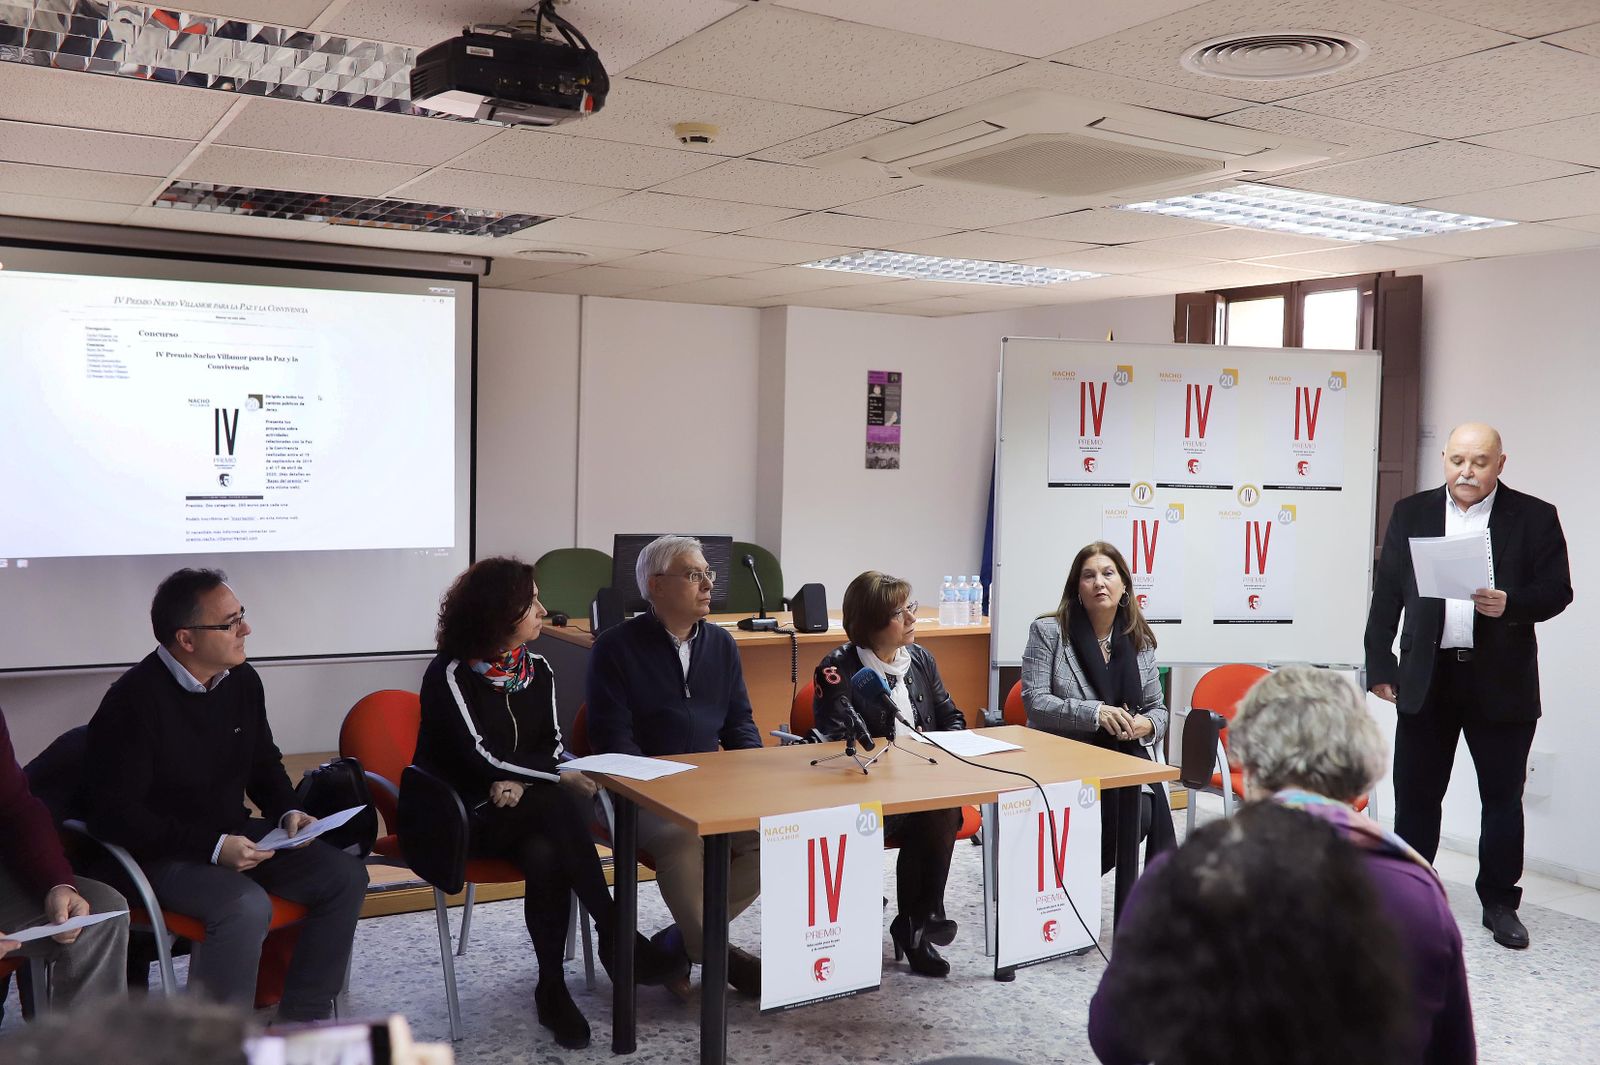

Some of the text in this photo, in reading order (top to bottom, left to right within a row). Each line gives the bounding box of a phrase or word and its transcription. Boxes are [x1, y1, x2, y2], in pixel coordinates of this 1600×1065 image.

[138, 329, 178, 338] Concurso
[1115, 372, 1128, 383] 20
[1221, 375, 1233, 386] 20
[1330, 378, 1341, 388] 20
[1080, 382, 1108, 436] IV
[1185, 384, 1213, 438] IV
[1294, 387, 1321, 440] IV
[215, 408, 239, 455] IV
[1245, 489, 1252, 502] IV
[1167, 510, 1180, 521] 20
[1280, 510, 1292, 522] 20
[1132, 520, 1159, 574] IV
[1245, 521, 1272, 574] IV
[1080, 788, 1095, 805] 20
[1001, 800, 1032, 811] NACHO
[858, 812, 877, 832] 20
[764, 824, 800, 836] NACHO
[766, 834, 800, 842] VILLAMOR
[1037, 807, 1070, 892] IV
[807, 834, 847, 927] IV
[805, 927, 841, 941] PREMIO
